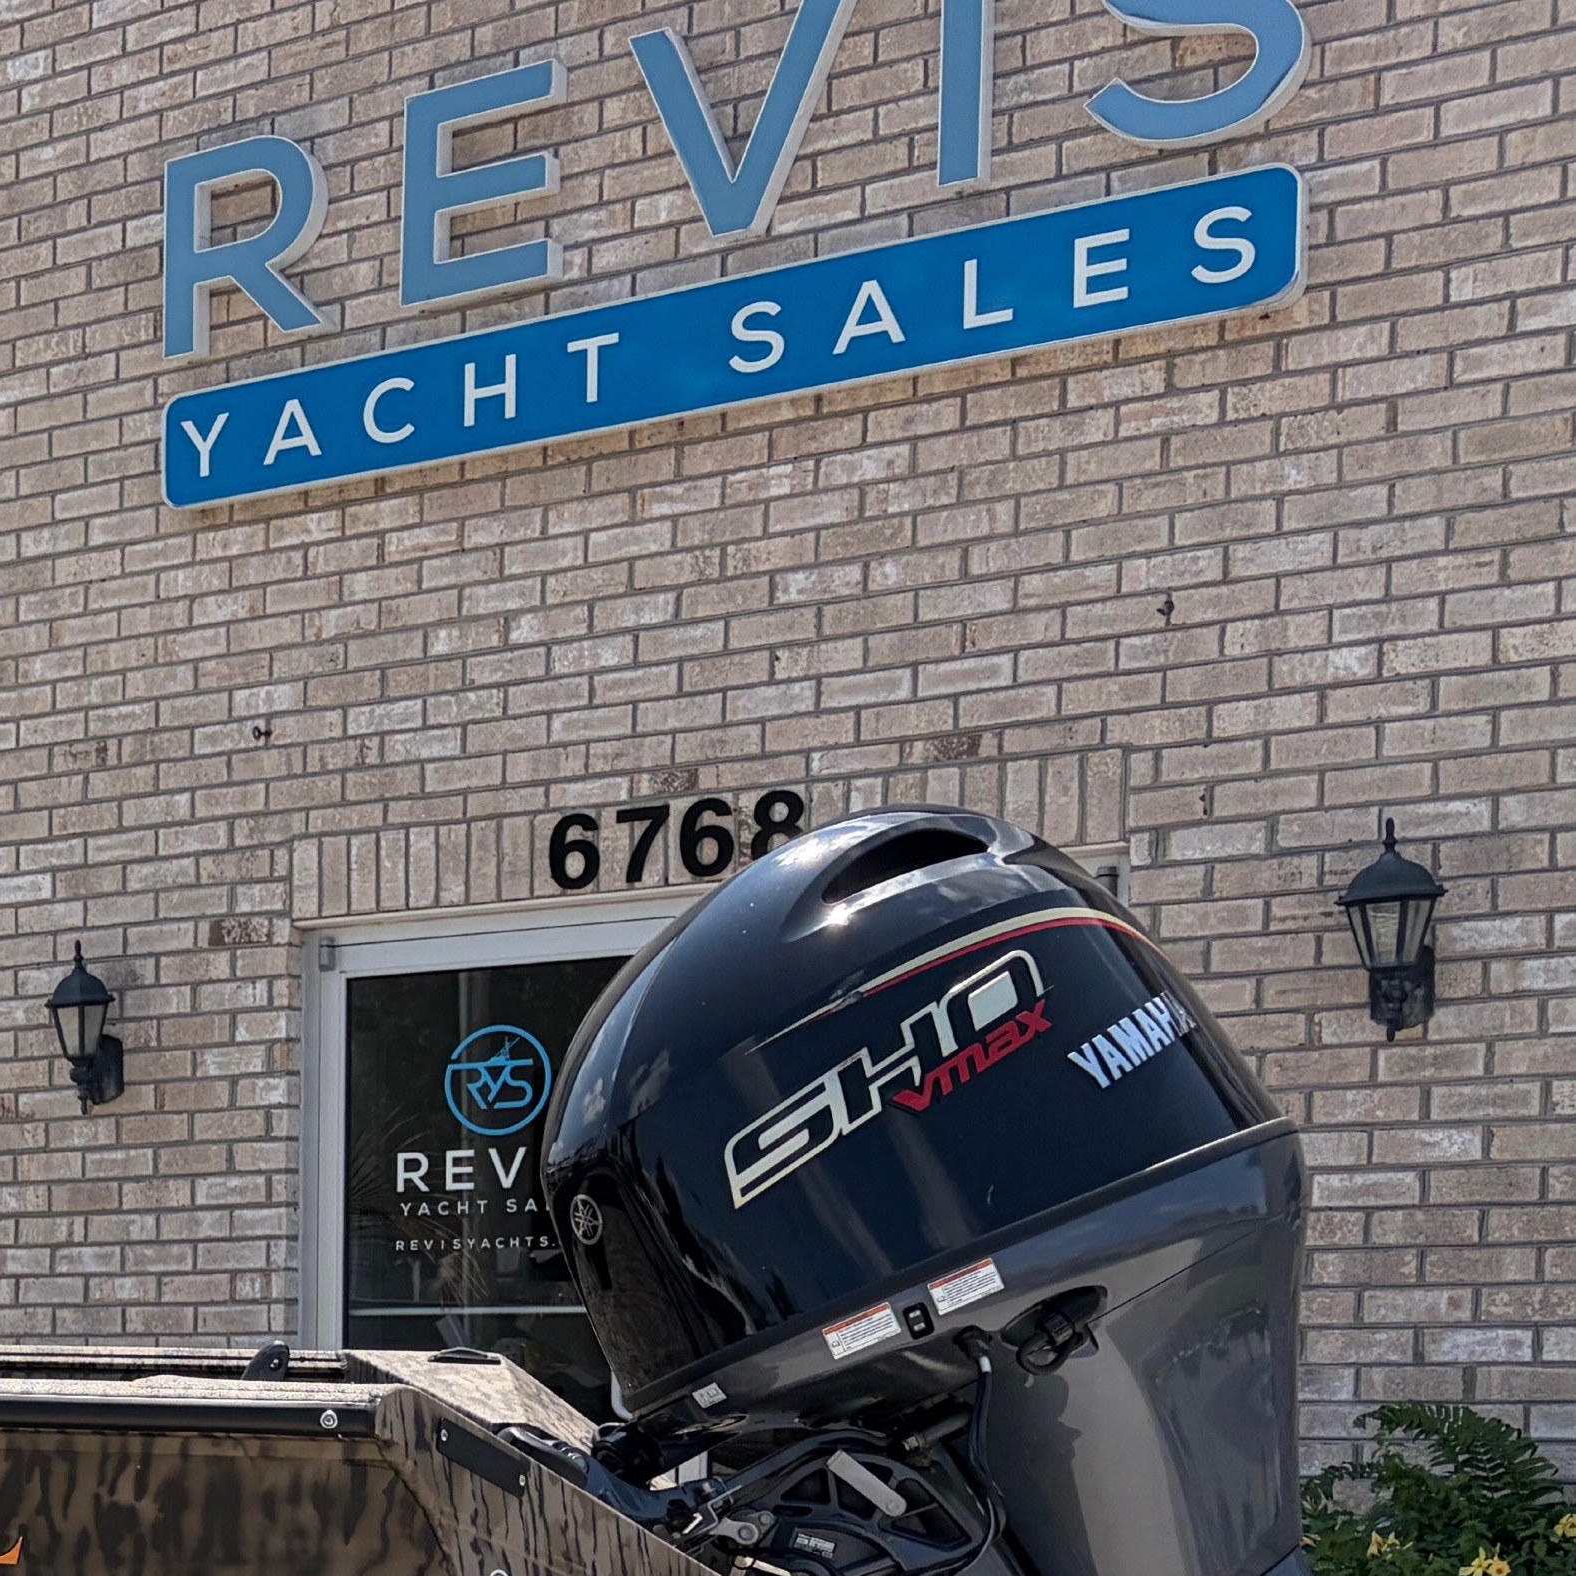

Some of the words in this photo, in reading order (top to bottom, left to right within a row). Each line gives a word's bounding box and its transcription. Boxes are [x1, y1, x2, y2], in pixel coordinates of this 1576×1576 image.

[162, 0, 1312, 360] REVIS
[180, 332, 621, 479] YACHT
[727, 206, 1258, 374] SALES
[548, 789, 805, 890] 6768
[723, 949, 1053, 1210] SHO
[1066, 991, 1197, 1090] YAMAHA
[396, 1146, 528, 1193] REV
[400, 1200, 488, 1217] YACHT
